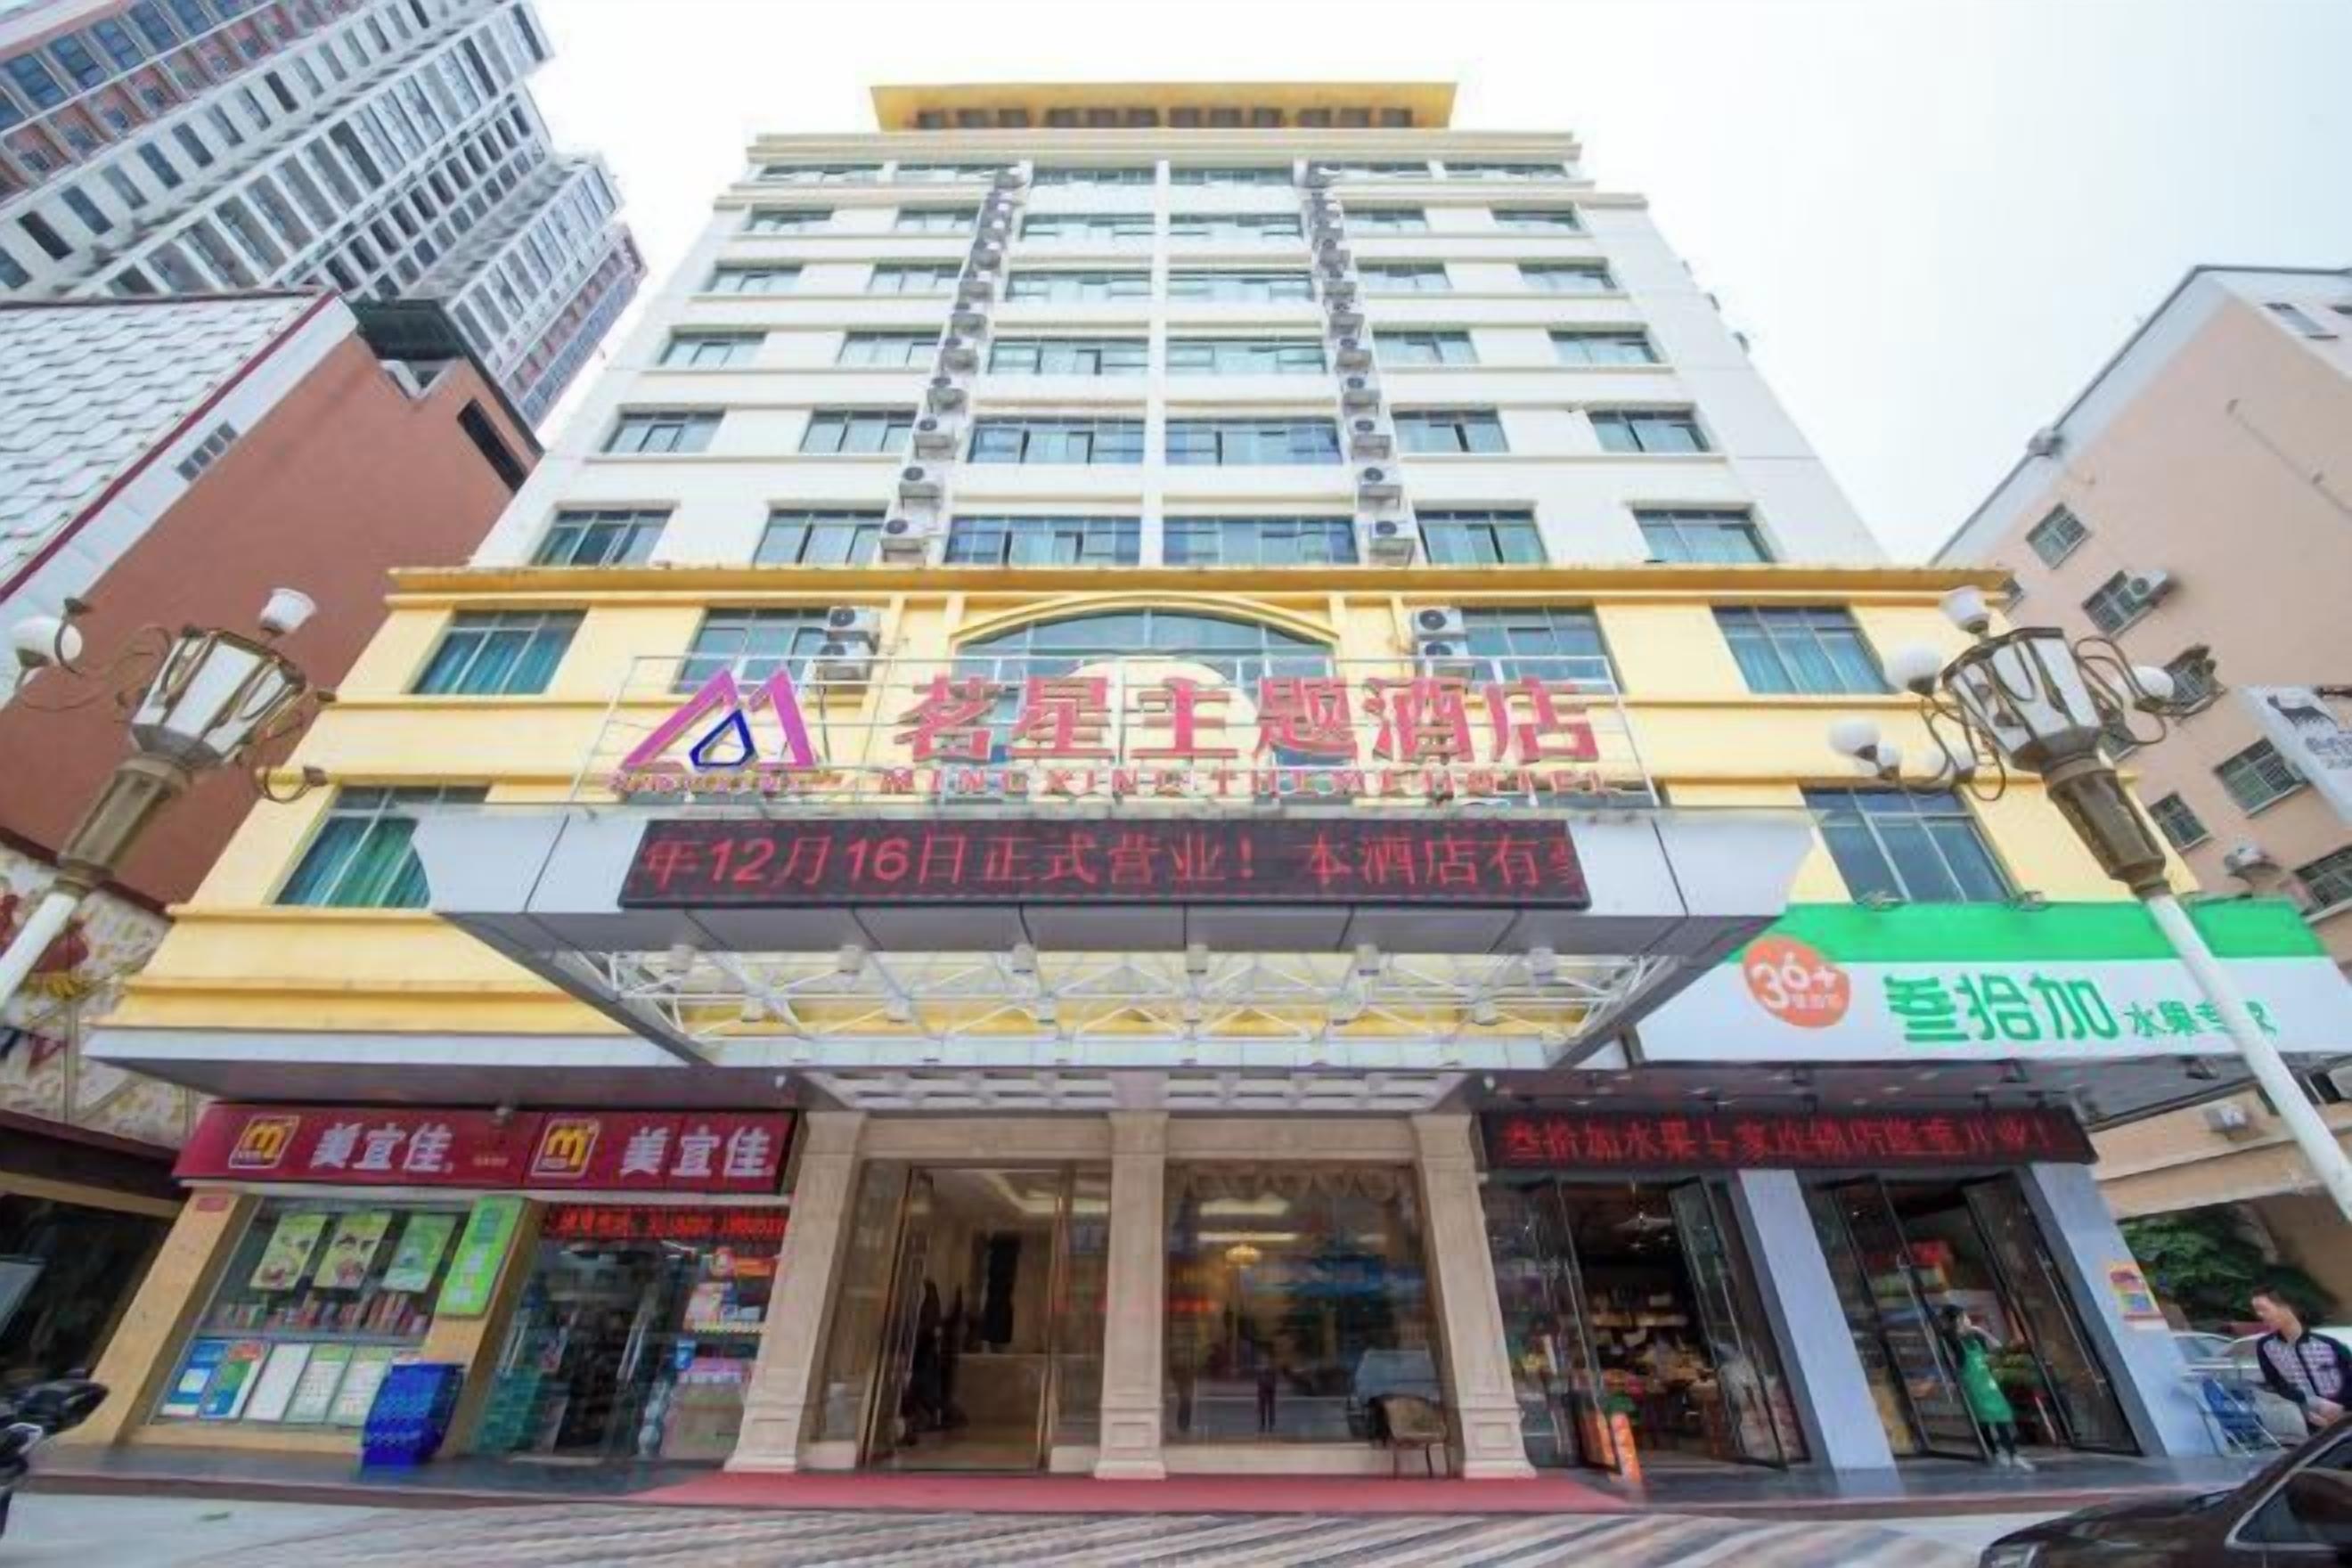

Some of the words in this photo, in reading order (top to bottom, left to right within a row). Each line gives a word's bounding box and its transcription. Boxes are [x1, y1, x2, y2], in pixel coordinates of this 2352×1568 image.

[893, 674, 1600, 764] 茗星主题酒店
[309, 1122, 453, 1172] 美宜佳
[619, 1125, 773, 1177] 美宜佳
